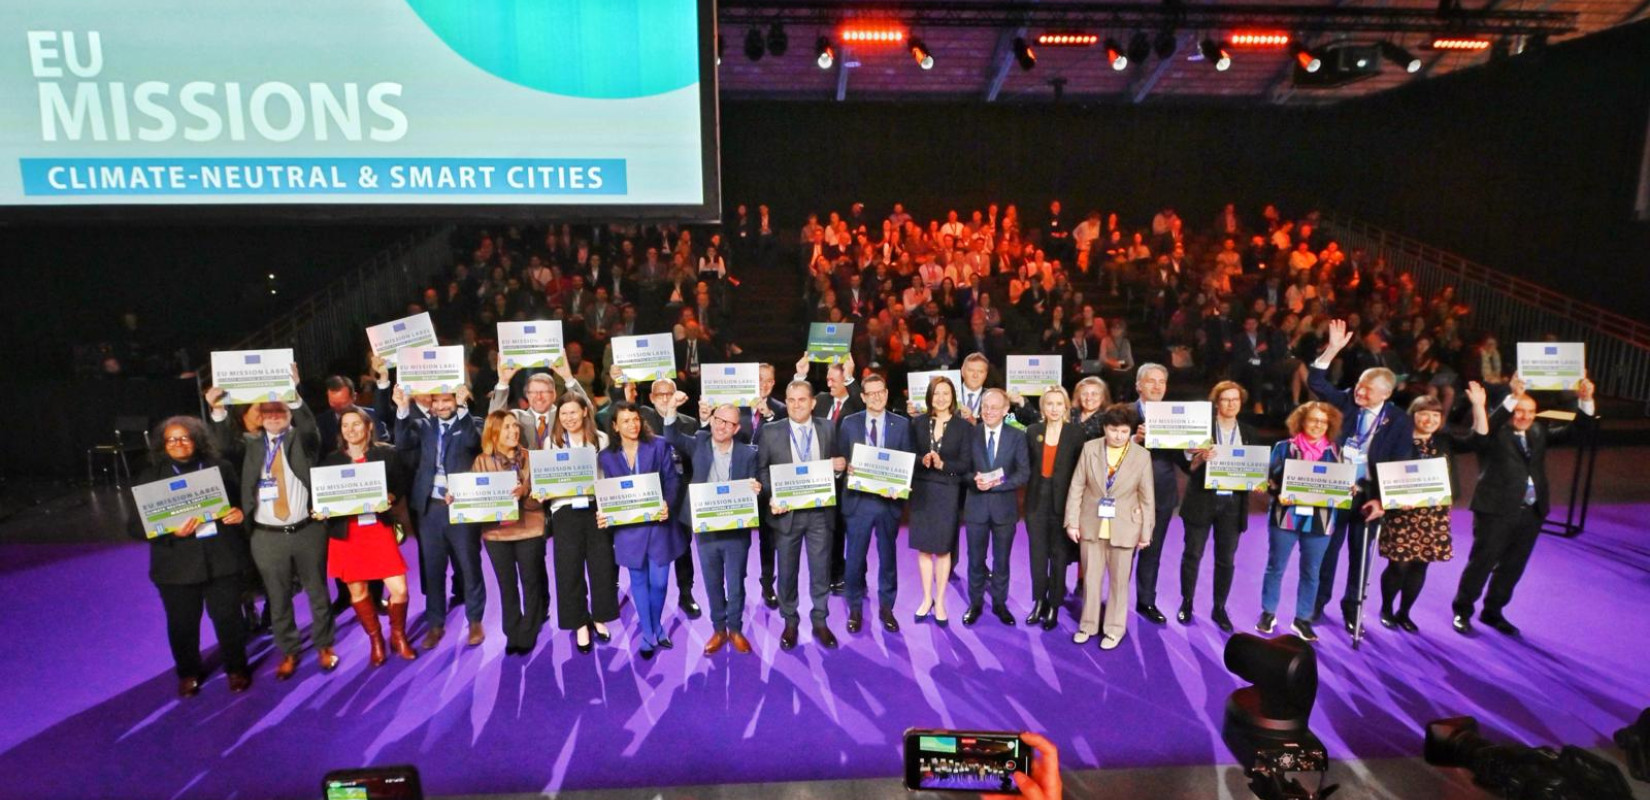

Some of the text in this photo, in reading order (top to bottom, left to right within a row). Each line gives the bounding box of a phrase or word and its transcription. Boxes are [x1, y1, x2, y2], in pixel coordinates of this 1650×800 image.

[27, 31, 104, 78] EU
[39, 81, 409, 142] MISSIONS
[48, 165, 604, 190] CLIMATE-NEUTRAL & SMART CITIES
[229, 369, 264, 377] MISSION
[265, 367, 290, 375] LABEL
[543, 465, 572, 473] MISSION
[784, 478, 811, 486] MISSION
[1297, 476, 1327, 484] MISSION
[326, 483, 359, 491] MISSION
[142, 485, 221, 511] EU MISSION LABEL
[704, 498, 732, 506] MISSION
[733, 496, 754, 504] LABEL
